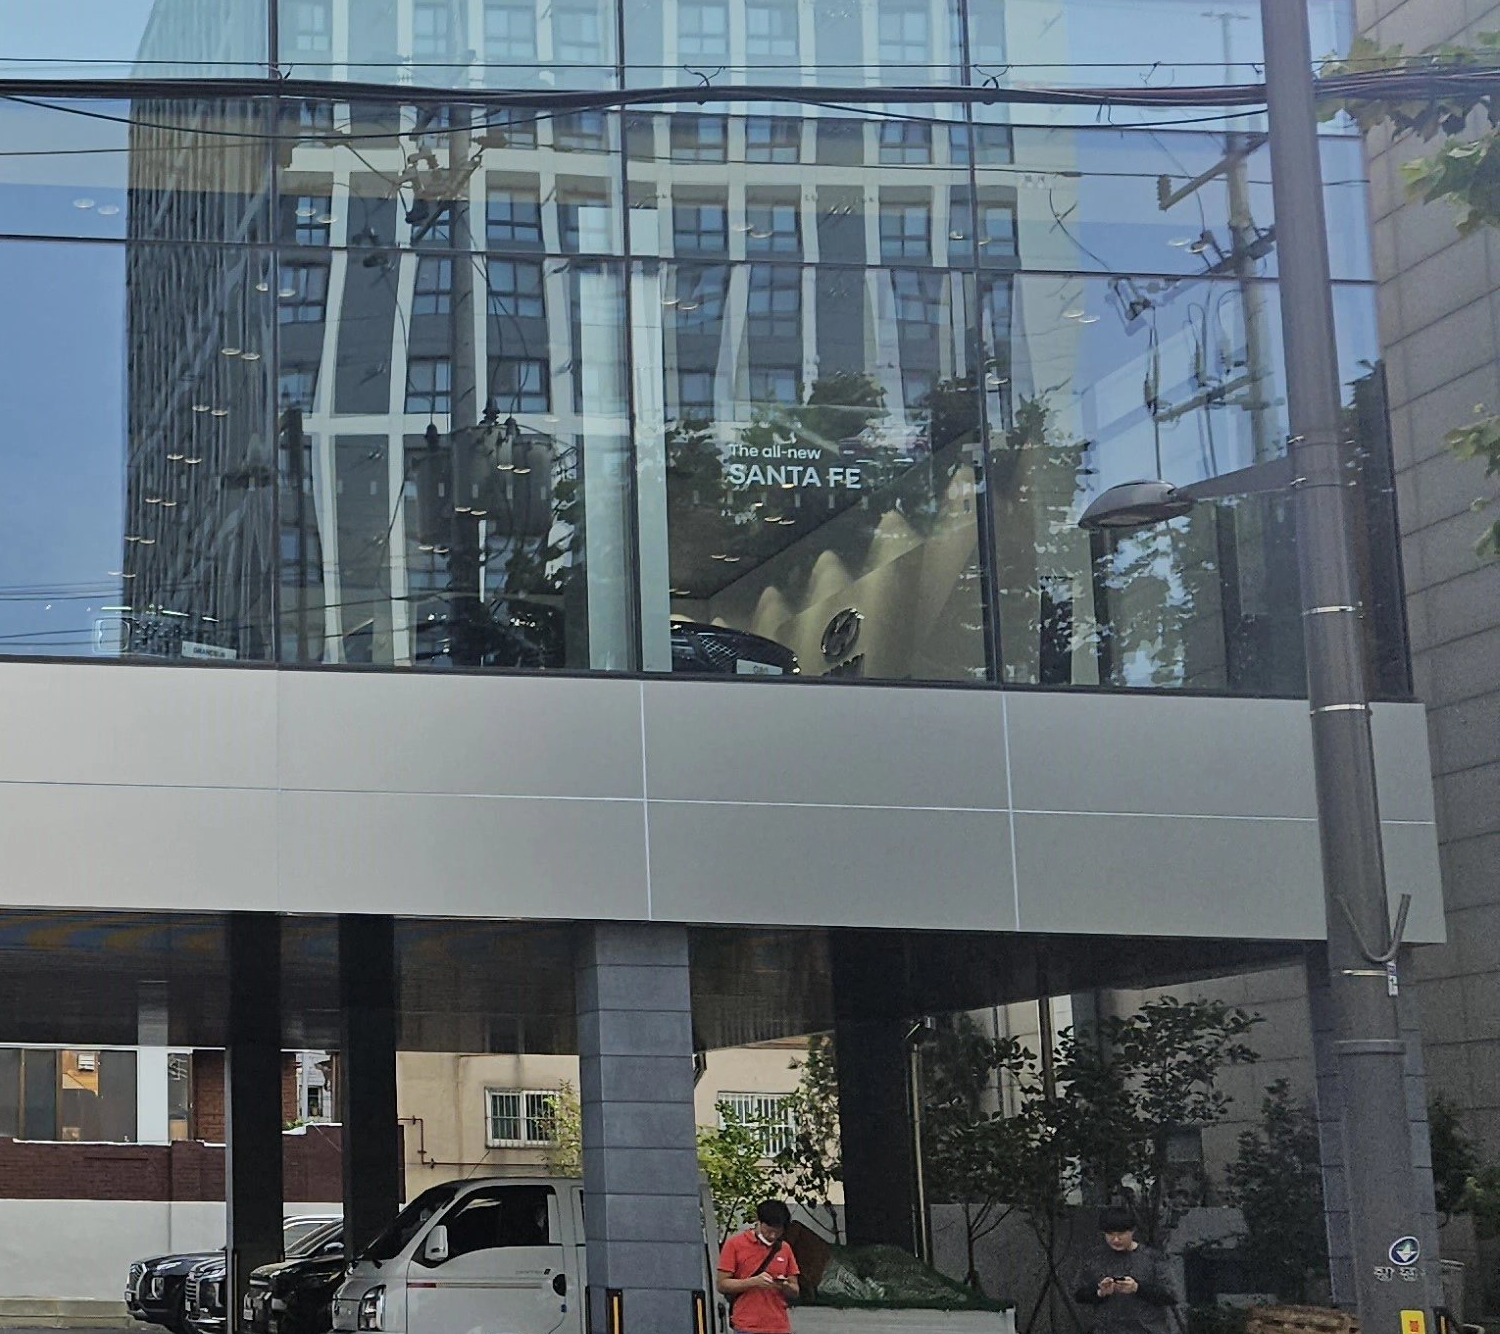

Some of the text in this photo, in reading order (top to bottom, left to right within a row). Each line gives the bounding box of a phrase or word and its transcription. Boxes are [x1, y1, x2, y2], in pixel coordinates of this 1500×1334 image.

[729, 443, 821, 459] The all-new
[729, 464, 862, 489] SANTA FE
